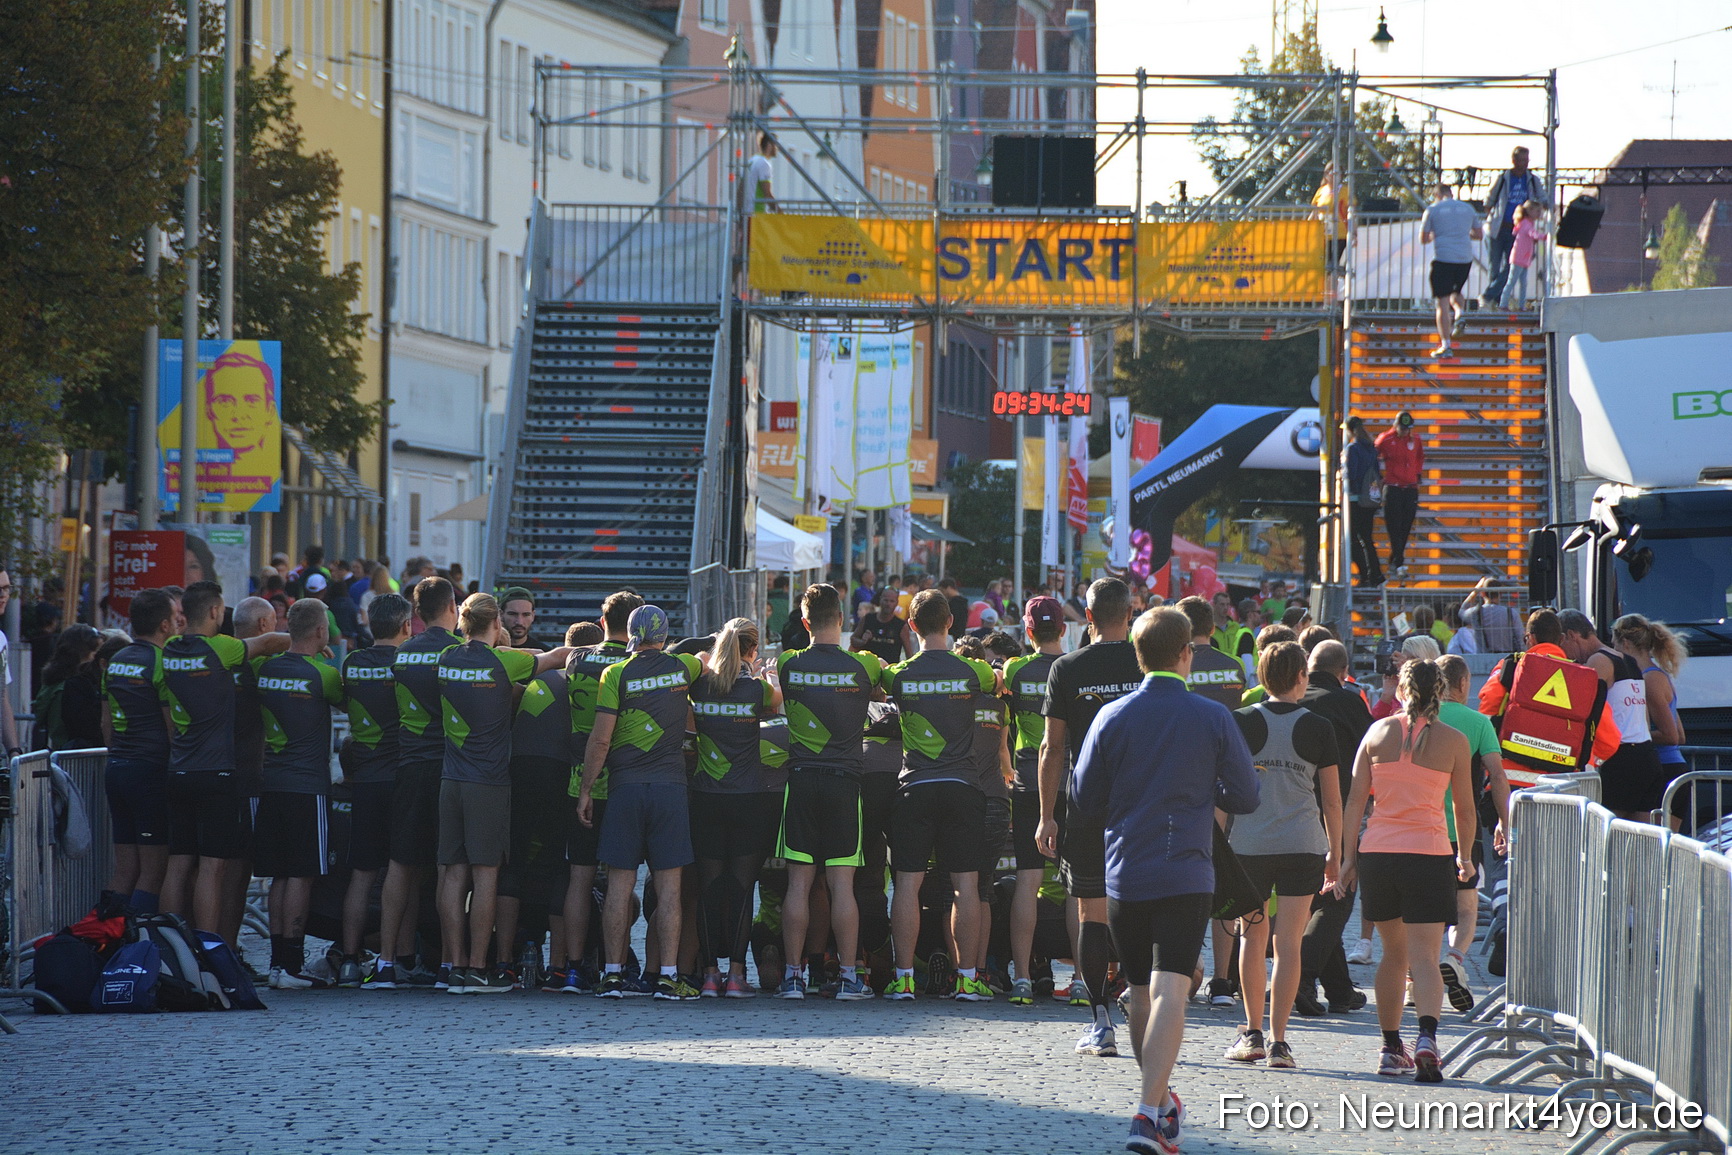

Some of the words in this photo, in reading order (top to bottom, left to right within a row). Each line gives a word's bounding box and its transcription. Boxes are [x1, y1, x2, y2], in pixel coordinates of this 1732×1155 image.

[781, 255, 848, 267] Neumarkter
[851, 258, 903, 270] Stadtlauf
[939, 237, 1134, 281] START
[1168, 263, 1236, 275] Neumarkter
[1238, 262, 1292, 274] Stadtlauf
[993, 392, 1091, 415] 09:34.24
[760, 444, 797, 466] RU
[1133, 480, 1169, 504] PARTL
[1167, 446, 1225, 487] NEUMARKT
[114, 540, 129, 551] Für
[130, 541, 158, 551] mehr
[113, 552, 156, 573] Frei-
[114, 575, 136, 585] statt
[107, 663, 145, 677] BOCK
[163, 657, 206, 671] BOCK
[438, 666, 492, 681] BOCK
[788, 671, 856, 686] BOCK
[257, 676, 310, 692] BOCK
[627, 671, 687, 692] BOCK
[902, 680, 969, 693] BOCK
[1078, 683, 1121, 695] MICHAEL
[1122, 681, 1142, 691] KLEI
[692, 702, 754, 716] BOCK
[1513, 734, 1568, 754] Sanitätsdienst
[1284, 760, 1306, 773] KLEIN
